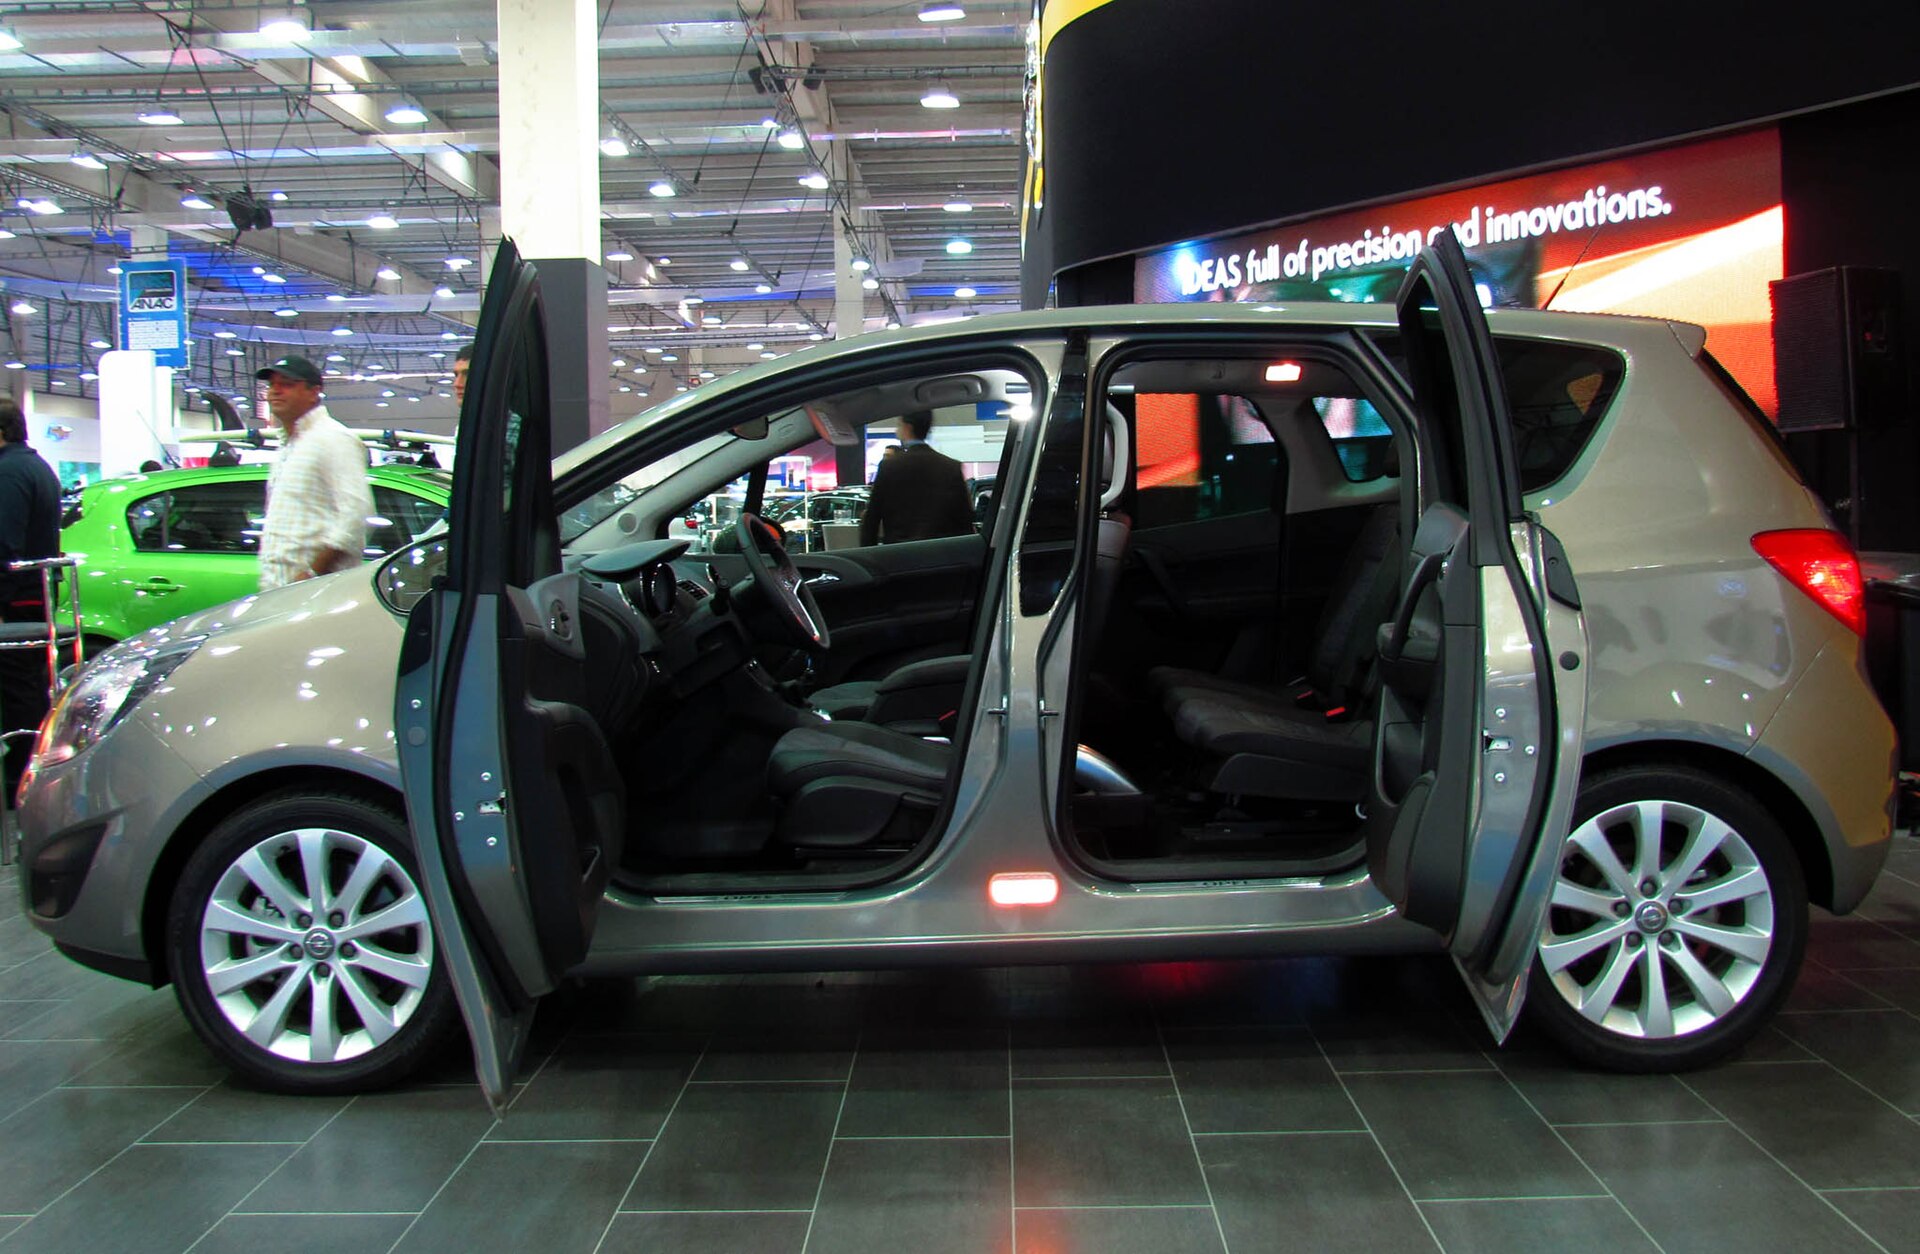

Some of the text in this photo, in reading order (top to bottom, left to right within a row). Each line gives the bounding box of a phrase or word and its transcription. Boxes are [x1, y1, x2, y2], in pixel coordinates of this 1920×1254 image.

[1181, 254, 1242, 295] IDEAS
[1246, 249, 1280, 284] full
[1283, 239, 1309, 277] of
[1312, 226, 1422, 281] precision
[1485, 185, 1672, 244] innovations.
[131, 297, 174, 310] ANAC
